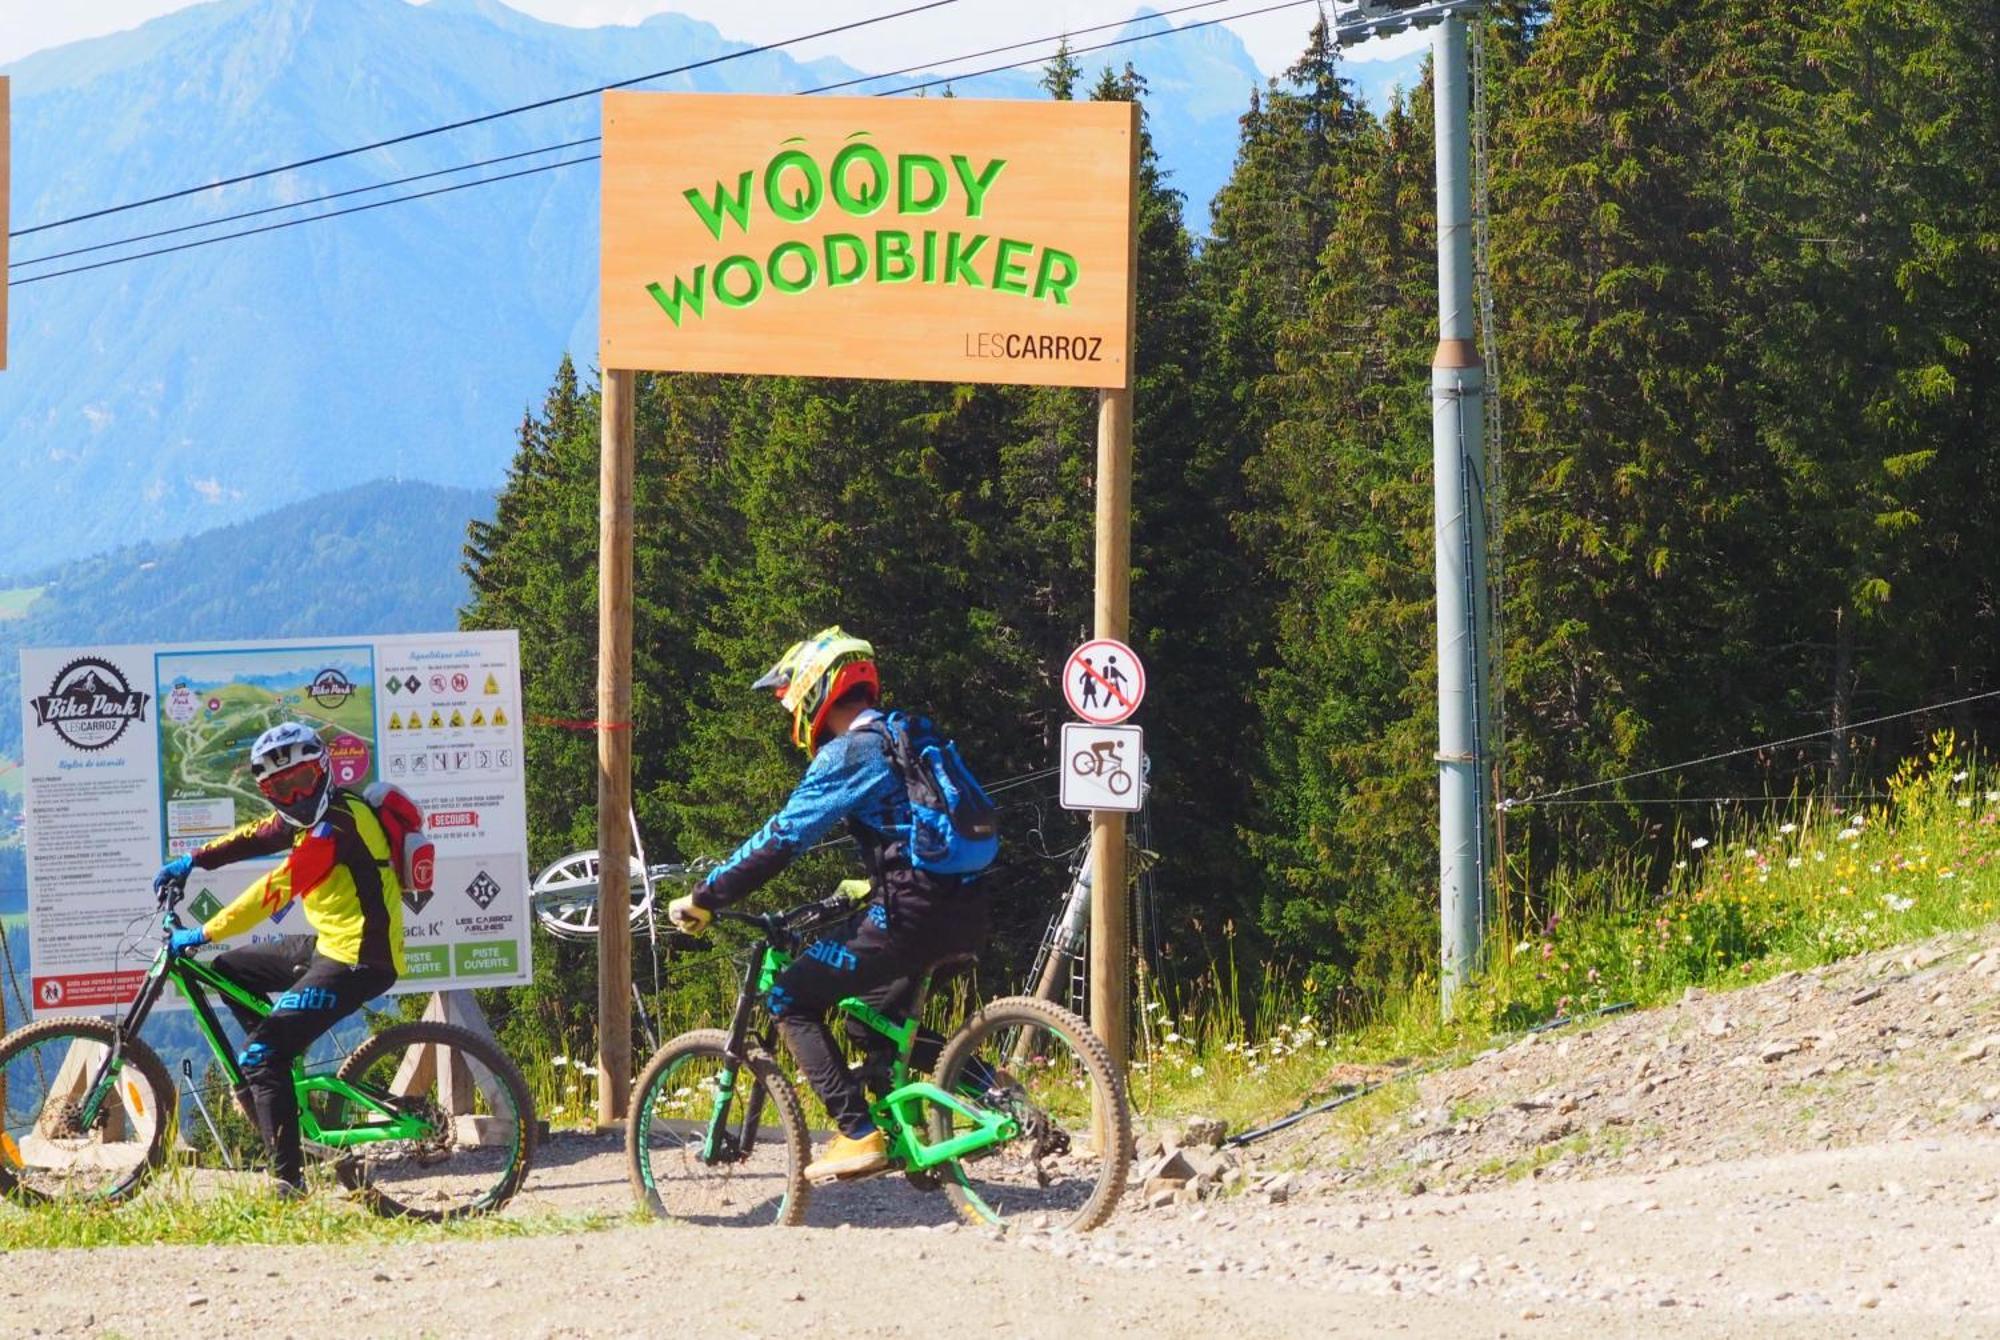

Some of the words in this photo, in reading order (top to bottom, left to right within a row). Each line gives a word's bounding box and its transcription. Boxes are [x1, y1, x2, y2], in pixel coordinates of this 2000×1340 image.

[682, 139, 1008, 242] WOODY
[645, 229, 1080, 328] WOODBIKER
[964, 332, 1103, 361] LESCARROZ
[46, 696, 89, 719] Bike
[89, 694, 138, 715] Park
[64, 720, 117, 733] LESCARROZ
[434, 812, 472, 826] SECOURS
[201, 901, 209, 916] 1
[455, 917, 473, 926] LES
[475, 914, 513, 923] CARROZ
[402, 925, 426, 937] ack
[472, 947, 500, 959] PISTE
[804, 940, 857, 971] aith
[407, 962, 442, 974] VERTE
[463, 957, 510, 970] OUVERTE
